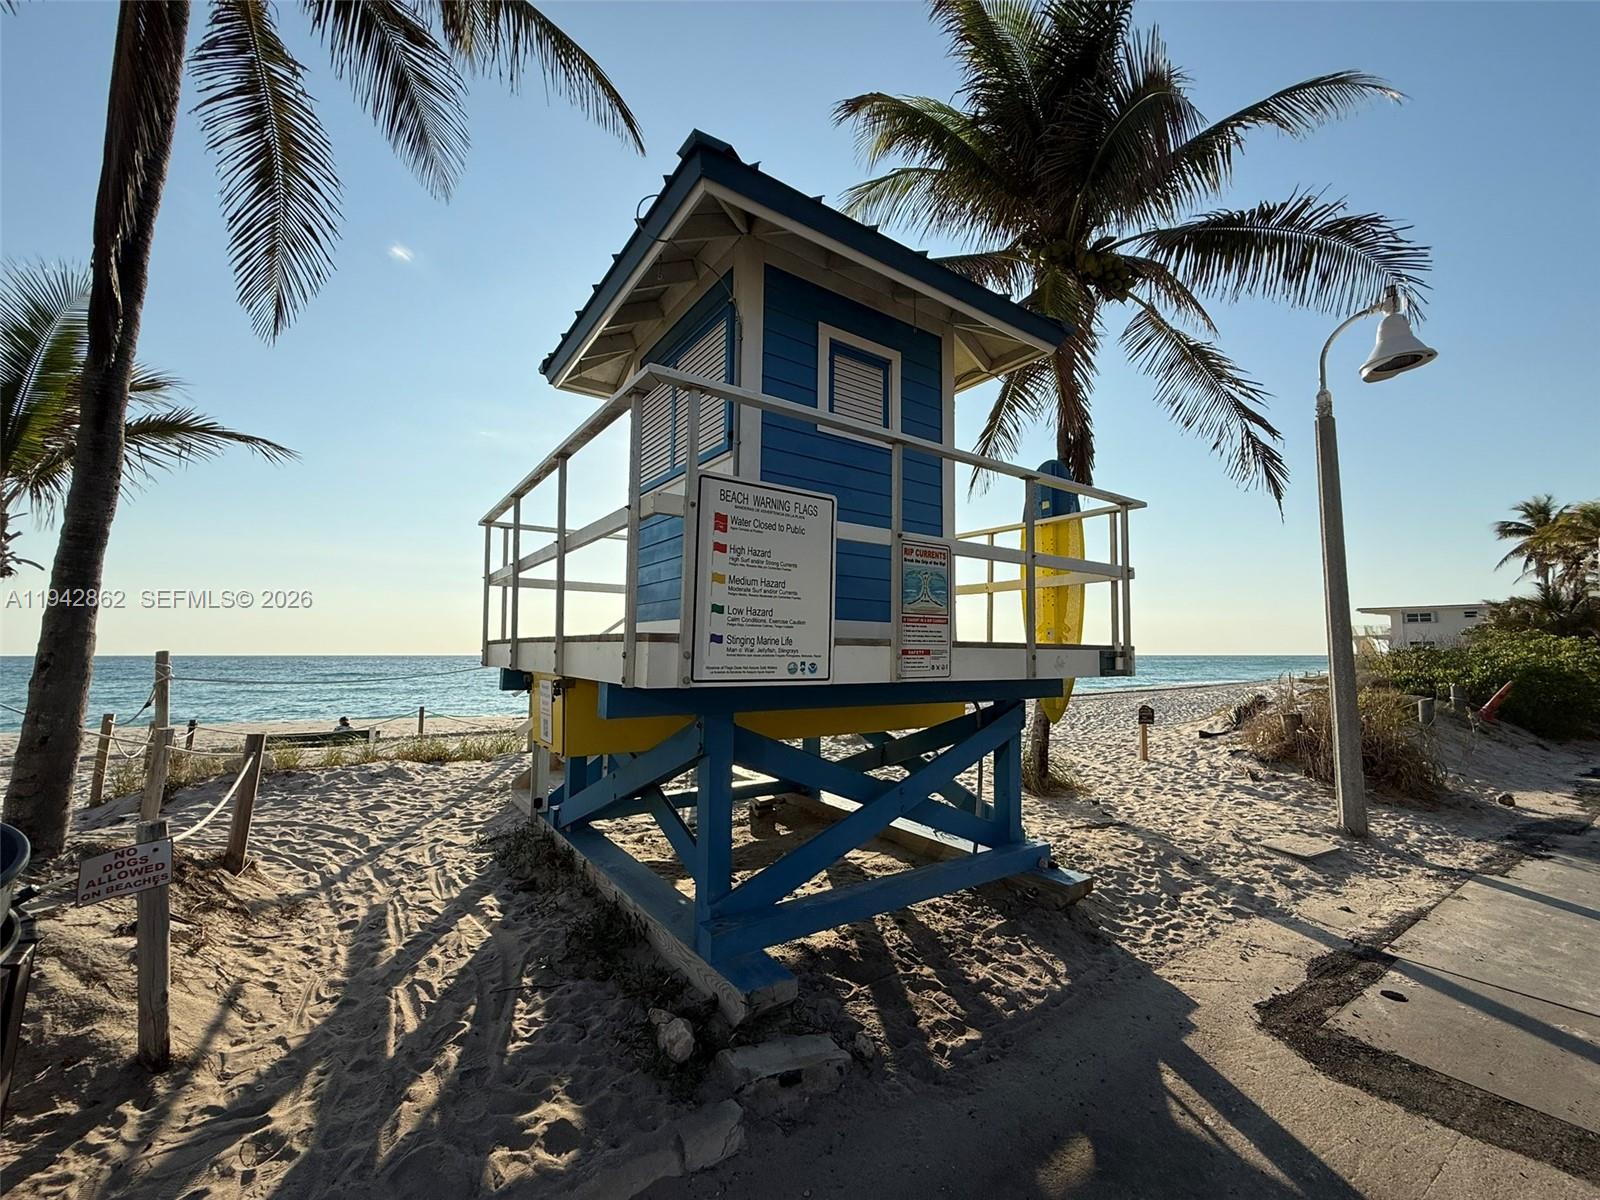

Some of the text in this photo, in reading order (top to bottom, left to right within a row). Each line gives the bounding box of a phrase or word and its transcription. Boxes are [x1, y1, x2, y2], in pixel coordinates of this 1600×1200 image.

[719, 489, 818, 517] BEACH WARNING FLAGS
[730, 515, 752, 527] Water
[752, 518, 776, 531] Closed
[778, 523, 785, 532] to
[786, 524, 806, 536] Public
[729, 544, 772, 559] High Hazard
[904, 547, 946, 560] RIP CURRENTS
[728, 574, 786, 589] Medium Hazard
[727, 605, 774, 617] Low Hazard
[726, 634, 793, 648] Stinging Marine Life
[114, 847, 138, 860] NO
[102, 855, 149, 874] DOGS
[85, 862, 166, 890] ALLOWED
[80, 872, 169, 902] ON BEACHES
